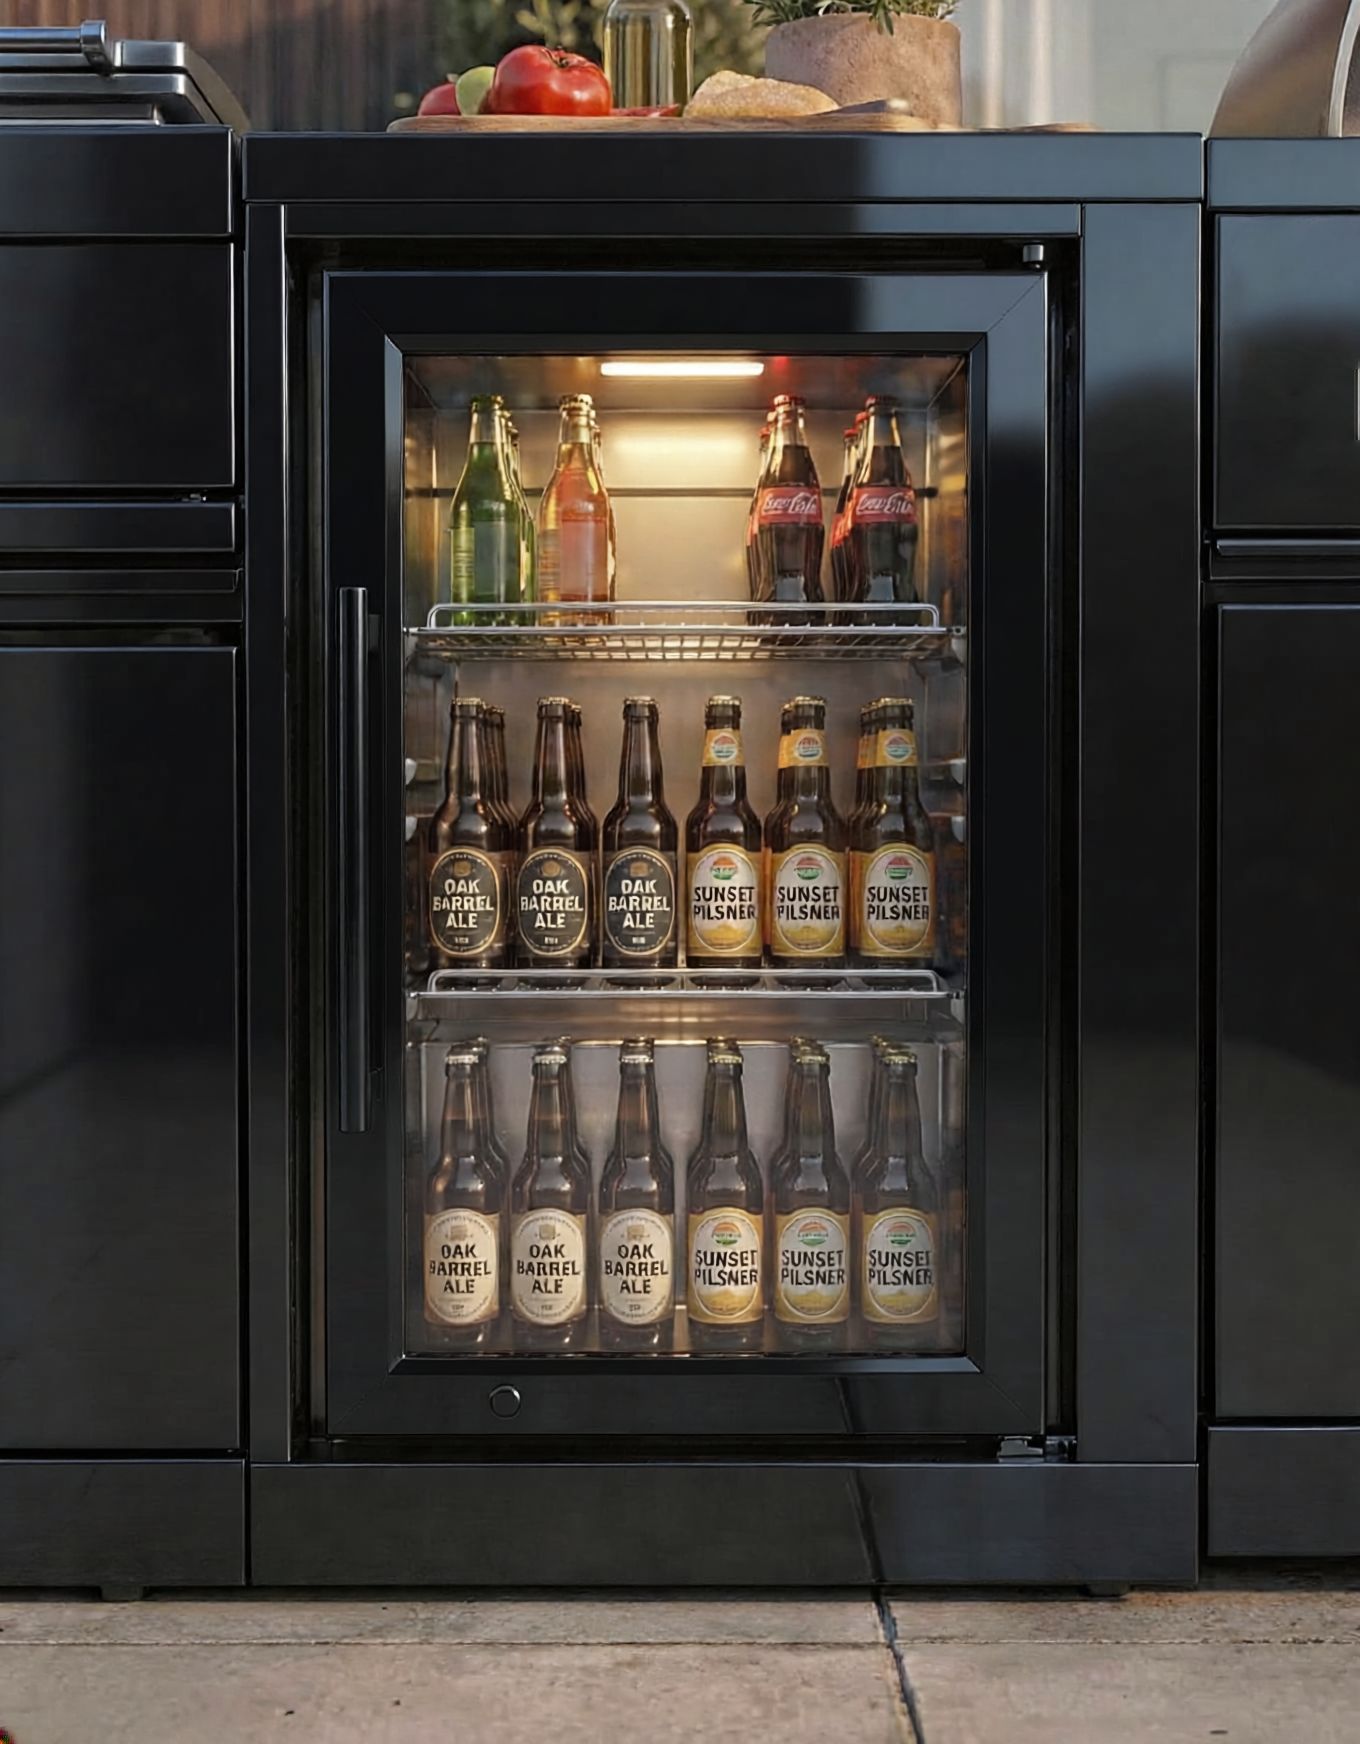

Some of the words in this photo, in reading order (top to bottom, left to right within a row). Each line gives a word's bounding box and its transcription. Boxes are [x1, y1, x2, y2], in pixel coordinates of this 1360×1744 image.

[445, 879, 480, 895] OAK
[533, 879, 569, 894] OAK
[621, 879, 657, 894] OAK
[693, 886, 755, 902] SUNSET
[778, 886, 840, 902] SUNSET
[867, 886, 929, 903] SUNSET
[433, 896, 494, 911] BARREL
[520, 896, 583, 911] BARREL
[608, 896, 670, 912] BARREL
[693, 904, 756, 920] PILSNER
[777, 904, 840, 920] PILSNER
[867, 904, 929, 920] PILSNER
[446, 913, 478, 928] ALE
[534, 913, 566, 929] ALE
[623, 913, 655, 928] ALE
[441, 1244, 477, 1258] OAK
[529, 1244, 565, 1258] OAK
[617, 1244, 654, 1258] OAK
[695, 1250, 758, 1267] SUNSET
[782, 1250, 844, 1267] SUNSET
[869, 1250, 932, 1267] SUNSET
[430, 1261, 492, 1276] BARREL
[517, 1261, 580, 1276] BARREL
[604, 1260, 669, 1276] BARREL
[695, 1268, 758, 1285] PILSNER
[782, 1268, 845, 1285] PILSNER
[869, 1268, 933, 1285] PILSNER
[443, 1278, 475, 1294] ALE
[532, 1278, 563, 1294] ALE
[620, 1278, 652, 1294] ALE
